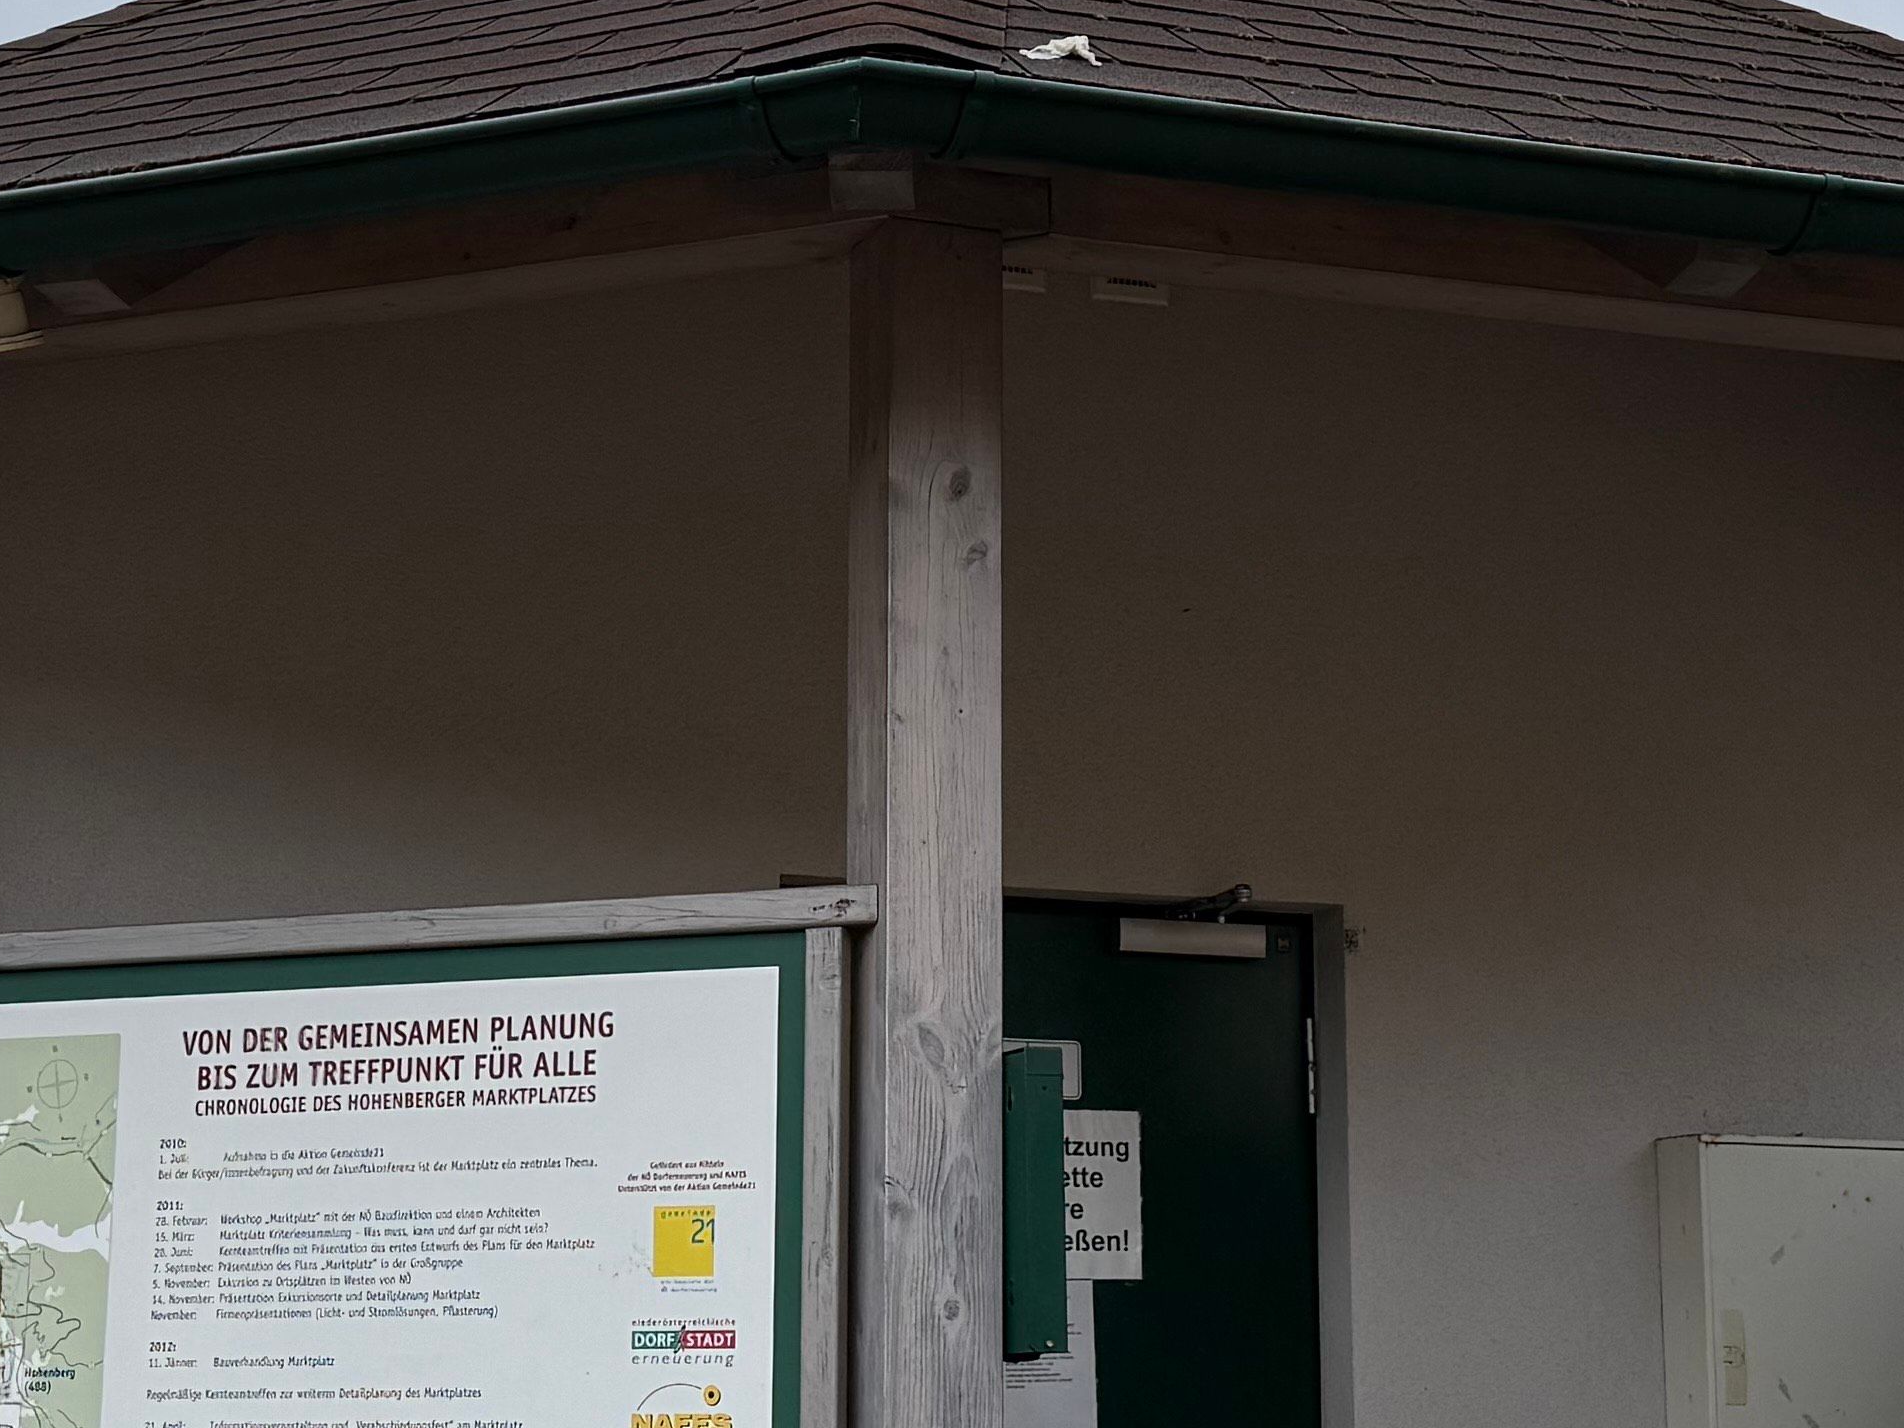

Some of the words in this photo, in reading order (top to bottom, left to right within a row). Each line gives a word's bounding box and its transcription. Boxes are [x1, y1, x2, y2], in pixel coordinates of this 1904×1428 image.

[182, 1029, 231, 1055] VON
[242, 1026, 288, 1052] DER
[298, 1018, 478, 1049] GEMEINSAMEN
[490, 1011, 614, 1041] PLANUNG
[197, 1064, 237, 1090] BIS
[245, 1062, 298, 1088] ZUM
[308, 1055, 465, 1085] TREFFPUNKT
[474, 1046, 523, 1079] FÜR
[532, 1049, 596, 1077] ALLE
[194, 1096, 307, 1116] CHRONOLOGIE
[312, 1094, 342, 1112] DES
[348, 1090, 466, 1110] HOHENBERGER
[472, 1085, 596, 1105] MARKTPLATZES
[159, 1138, 186, 1149] 2010:
[1064, 1137, 1129, 1162] tzung
[1064, 1166, 1104, 1188] ette
[156, 1200, 184, 1211] 2011:
[691, 1218, 715, 1245] 21
[1064, 1230, 1128, 1252] eßen!
[149, 1341, 176, 1352] 2012:
[634, 1332, 675, 1348] DORF
[686, 1332, 734, 1347] STADT
[631, 1353, 734, 1368] erneuerung
[24, 1367, 76, 1380] Hohenberg
